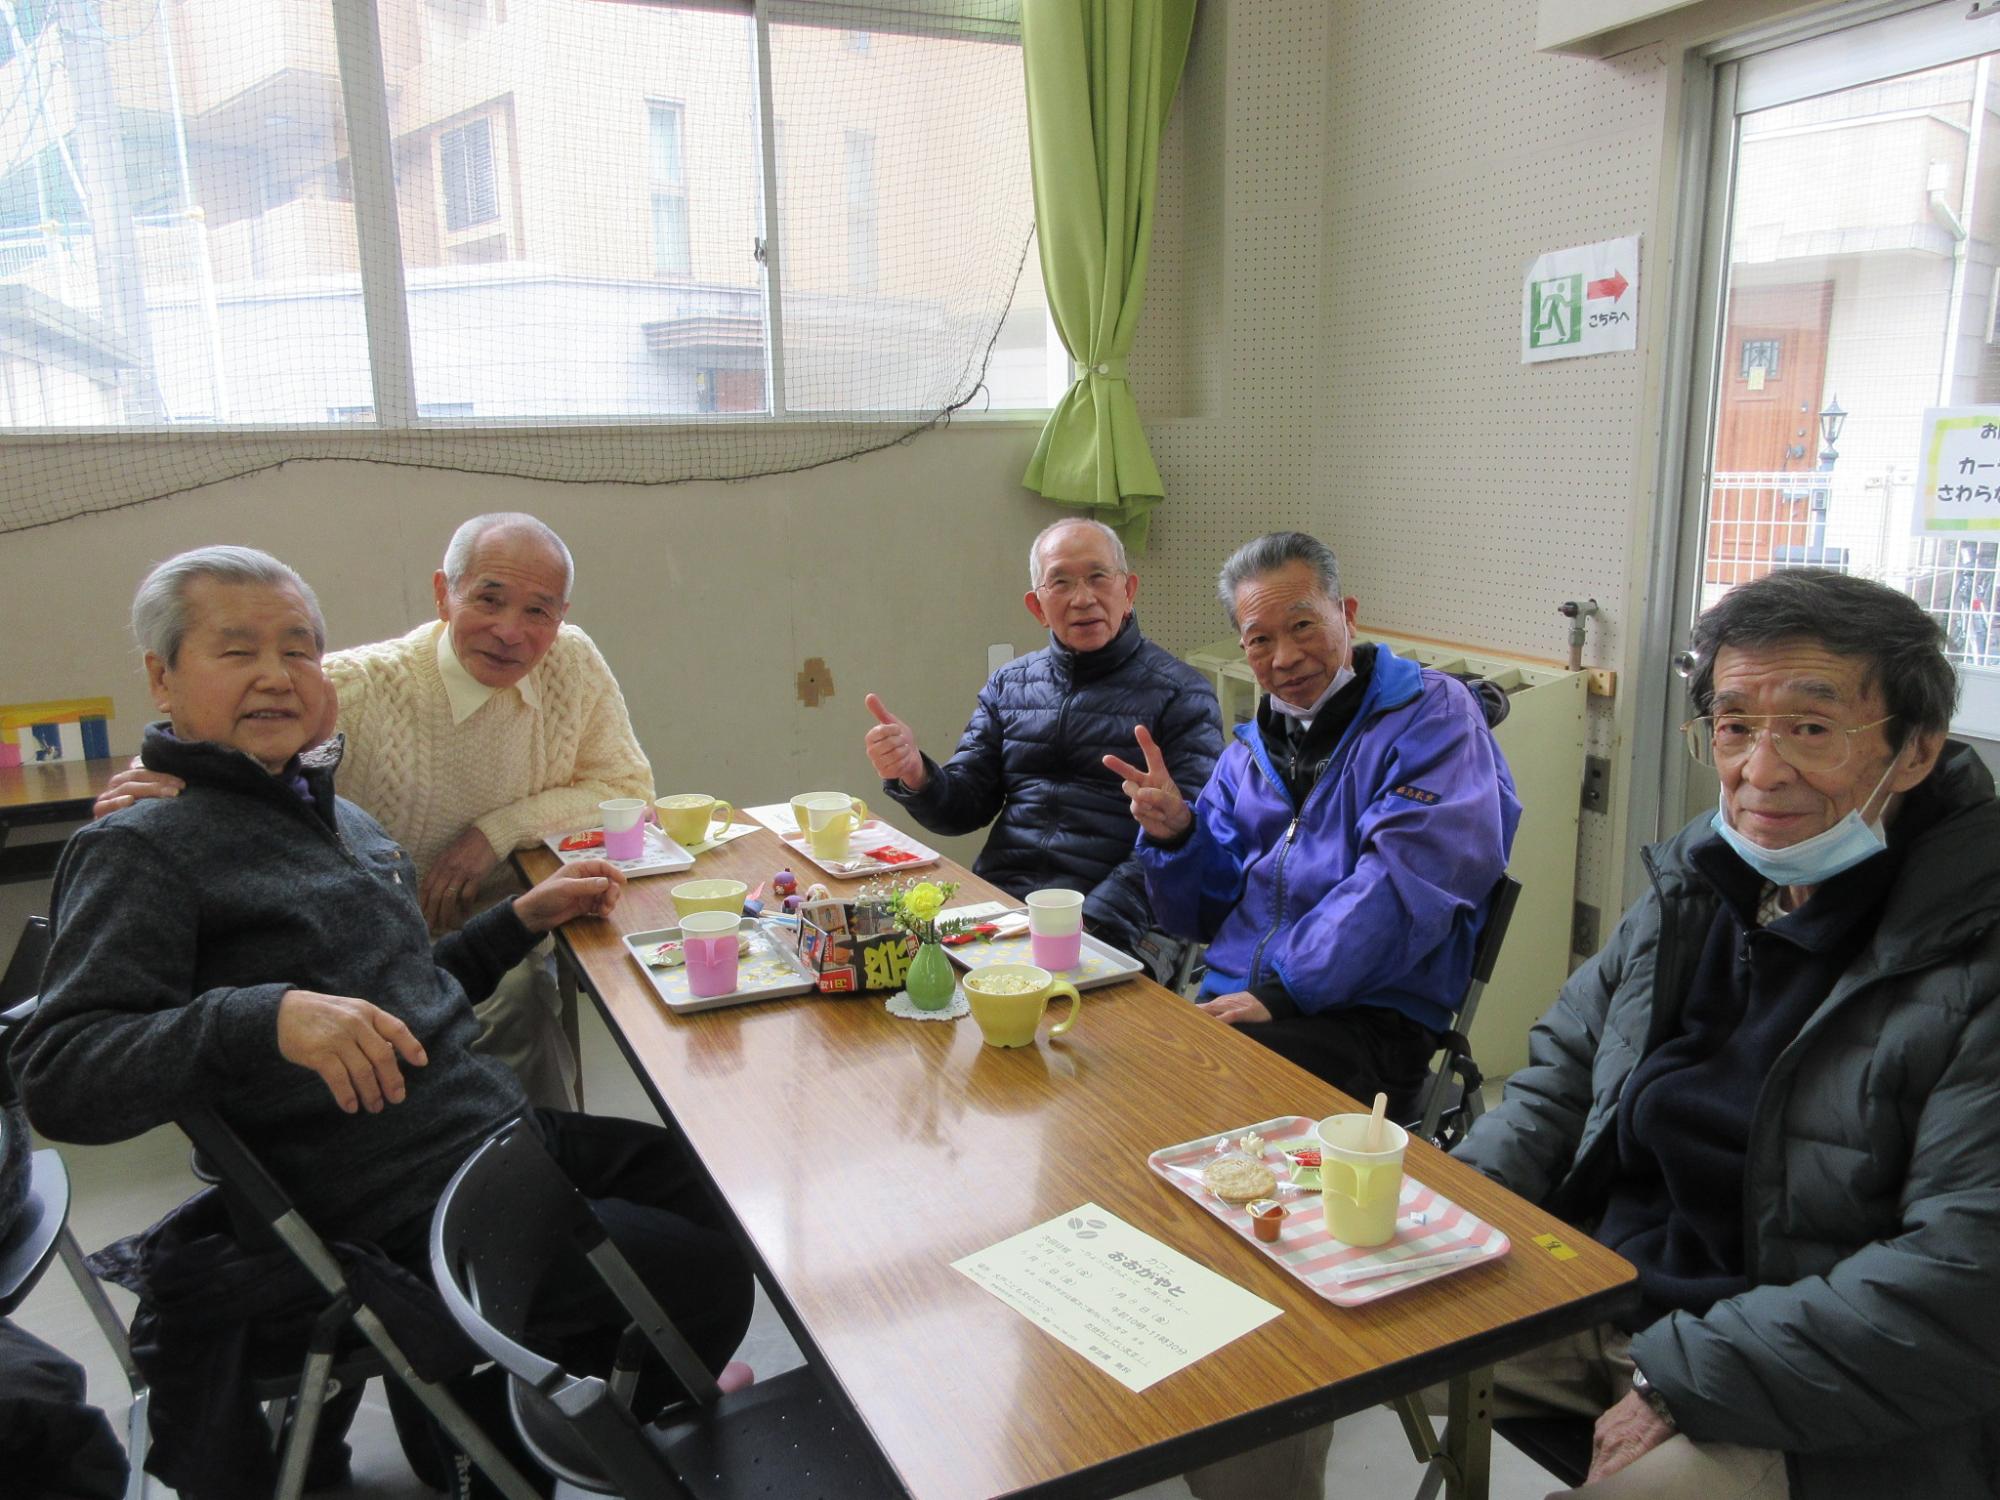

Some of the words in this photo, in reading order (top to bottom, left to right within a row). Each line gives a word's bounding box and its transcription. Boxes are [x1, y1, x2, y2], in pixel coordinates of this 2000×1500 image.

[1588, 312, 1630, 328] こちらへ
[1980, 422, 2000, 439] お
[1959, 457, 2000, 475] カー
[1106, 1250, 1188, 1298] おおがやと
[1144, 1256, 1176, 1275] カフェ
